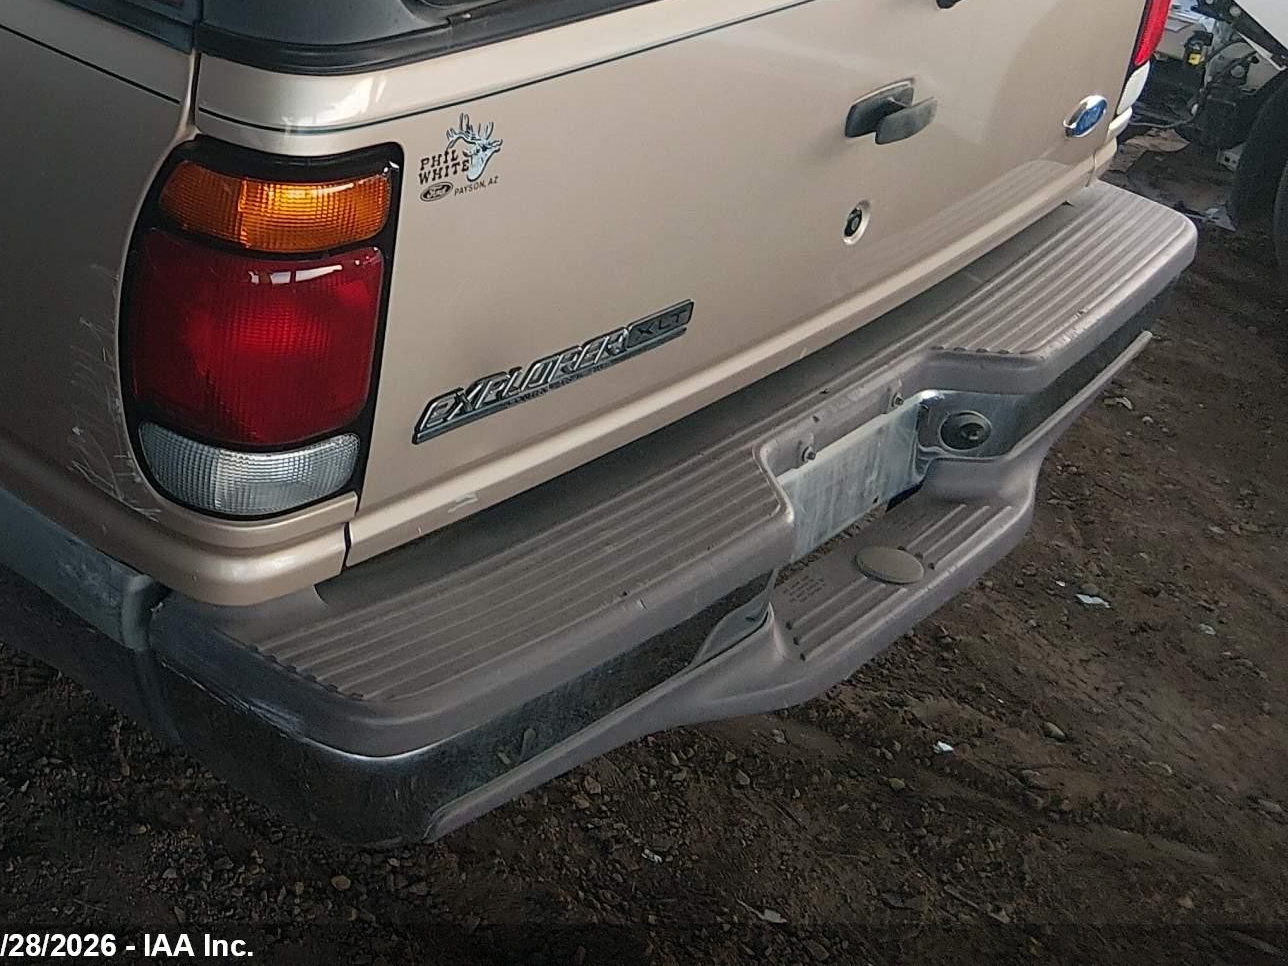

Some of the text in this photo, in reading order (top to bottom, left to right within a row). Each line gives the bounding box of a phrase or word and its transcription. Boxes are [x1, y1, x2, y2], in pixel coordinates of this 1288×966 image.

[418, 159, 470, 185] WHITE
[420, 149, 459, 171] PHIL
[417, 308, 689, 433] EXPLORER XLT
